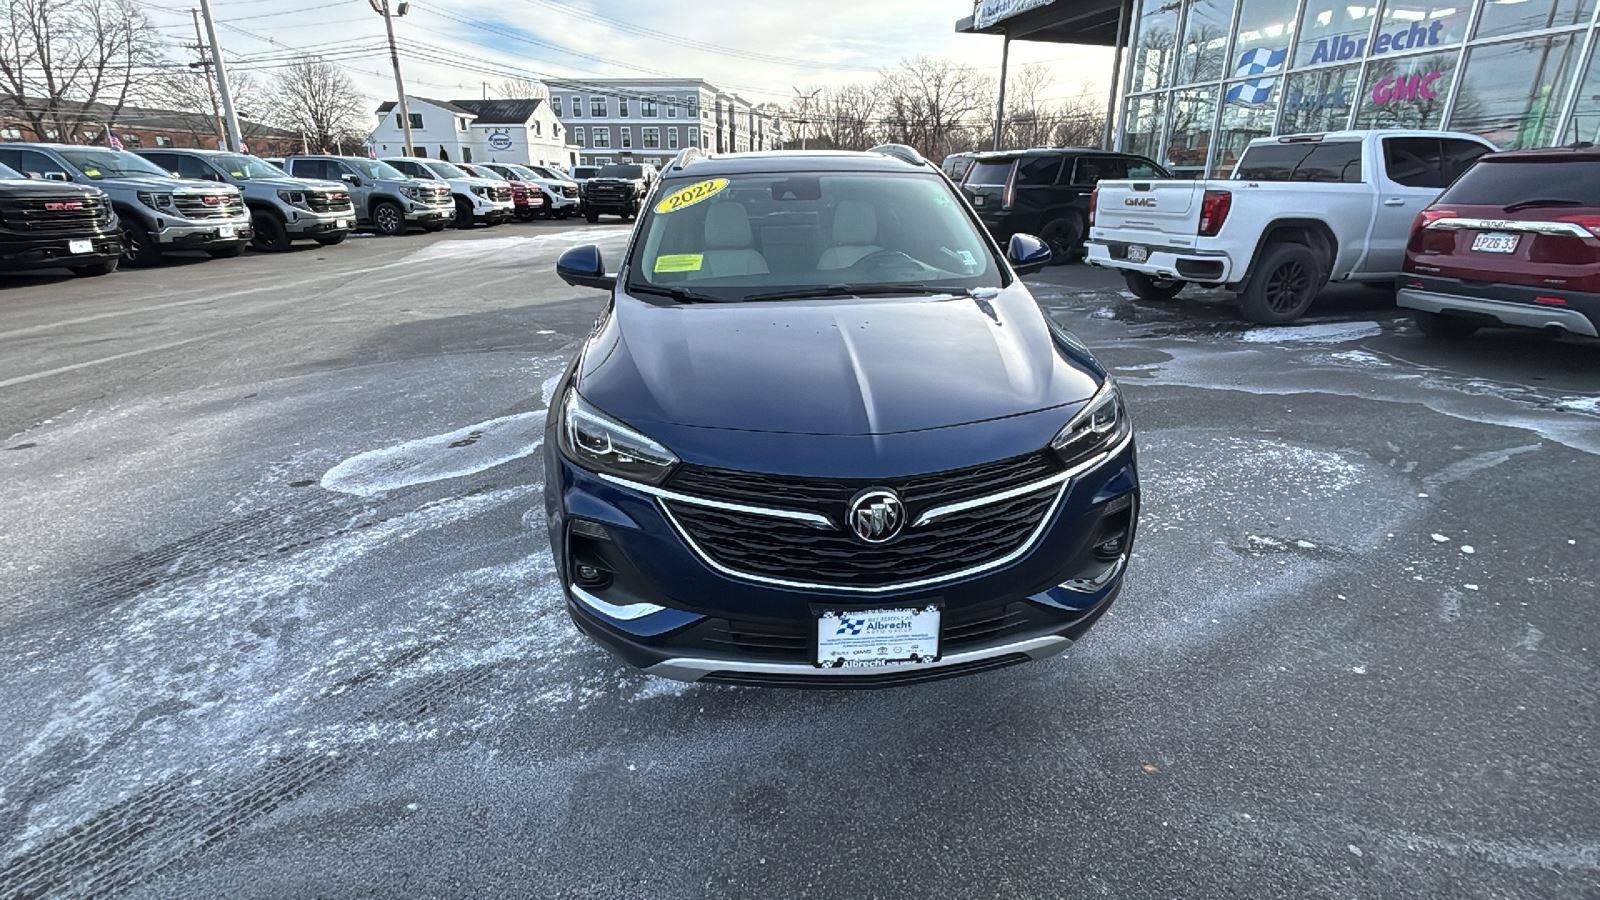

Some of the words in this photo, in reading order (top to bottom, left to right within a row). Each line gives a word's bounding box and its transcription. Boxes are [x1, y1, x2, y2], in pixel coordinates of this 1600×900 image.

[1309, 19, 1443, 65] Albrecht
[1372, 71, 1442, 106] GMC
[669, 181, 717, 209] 2022
[45, 202, 83, 211] GMC
[1125, 197, 1157, 208] GMC
[866, 620, 912, 630] Albrecht
[842, 659, 887, 668] Albrecht
